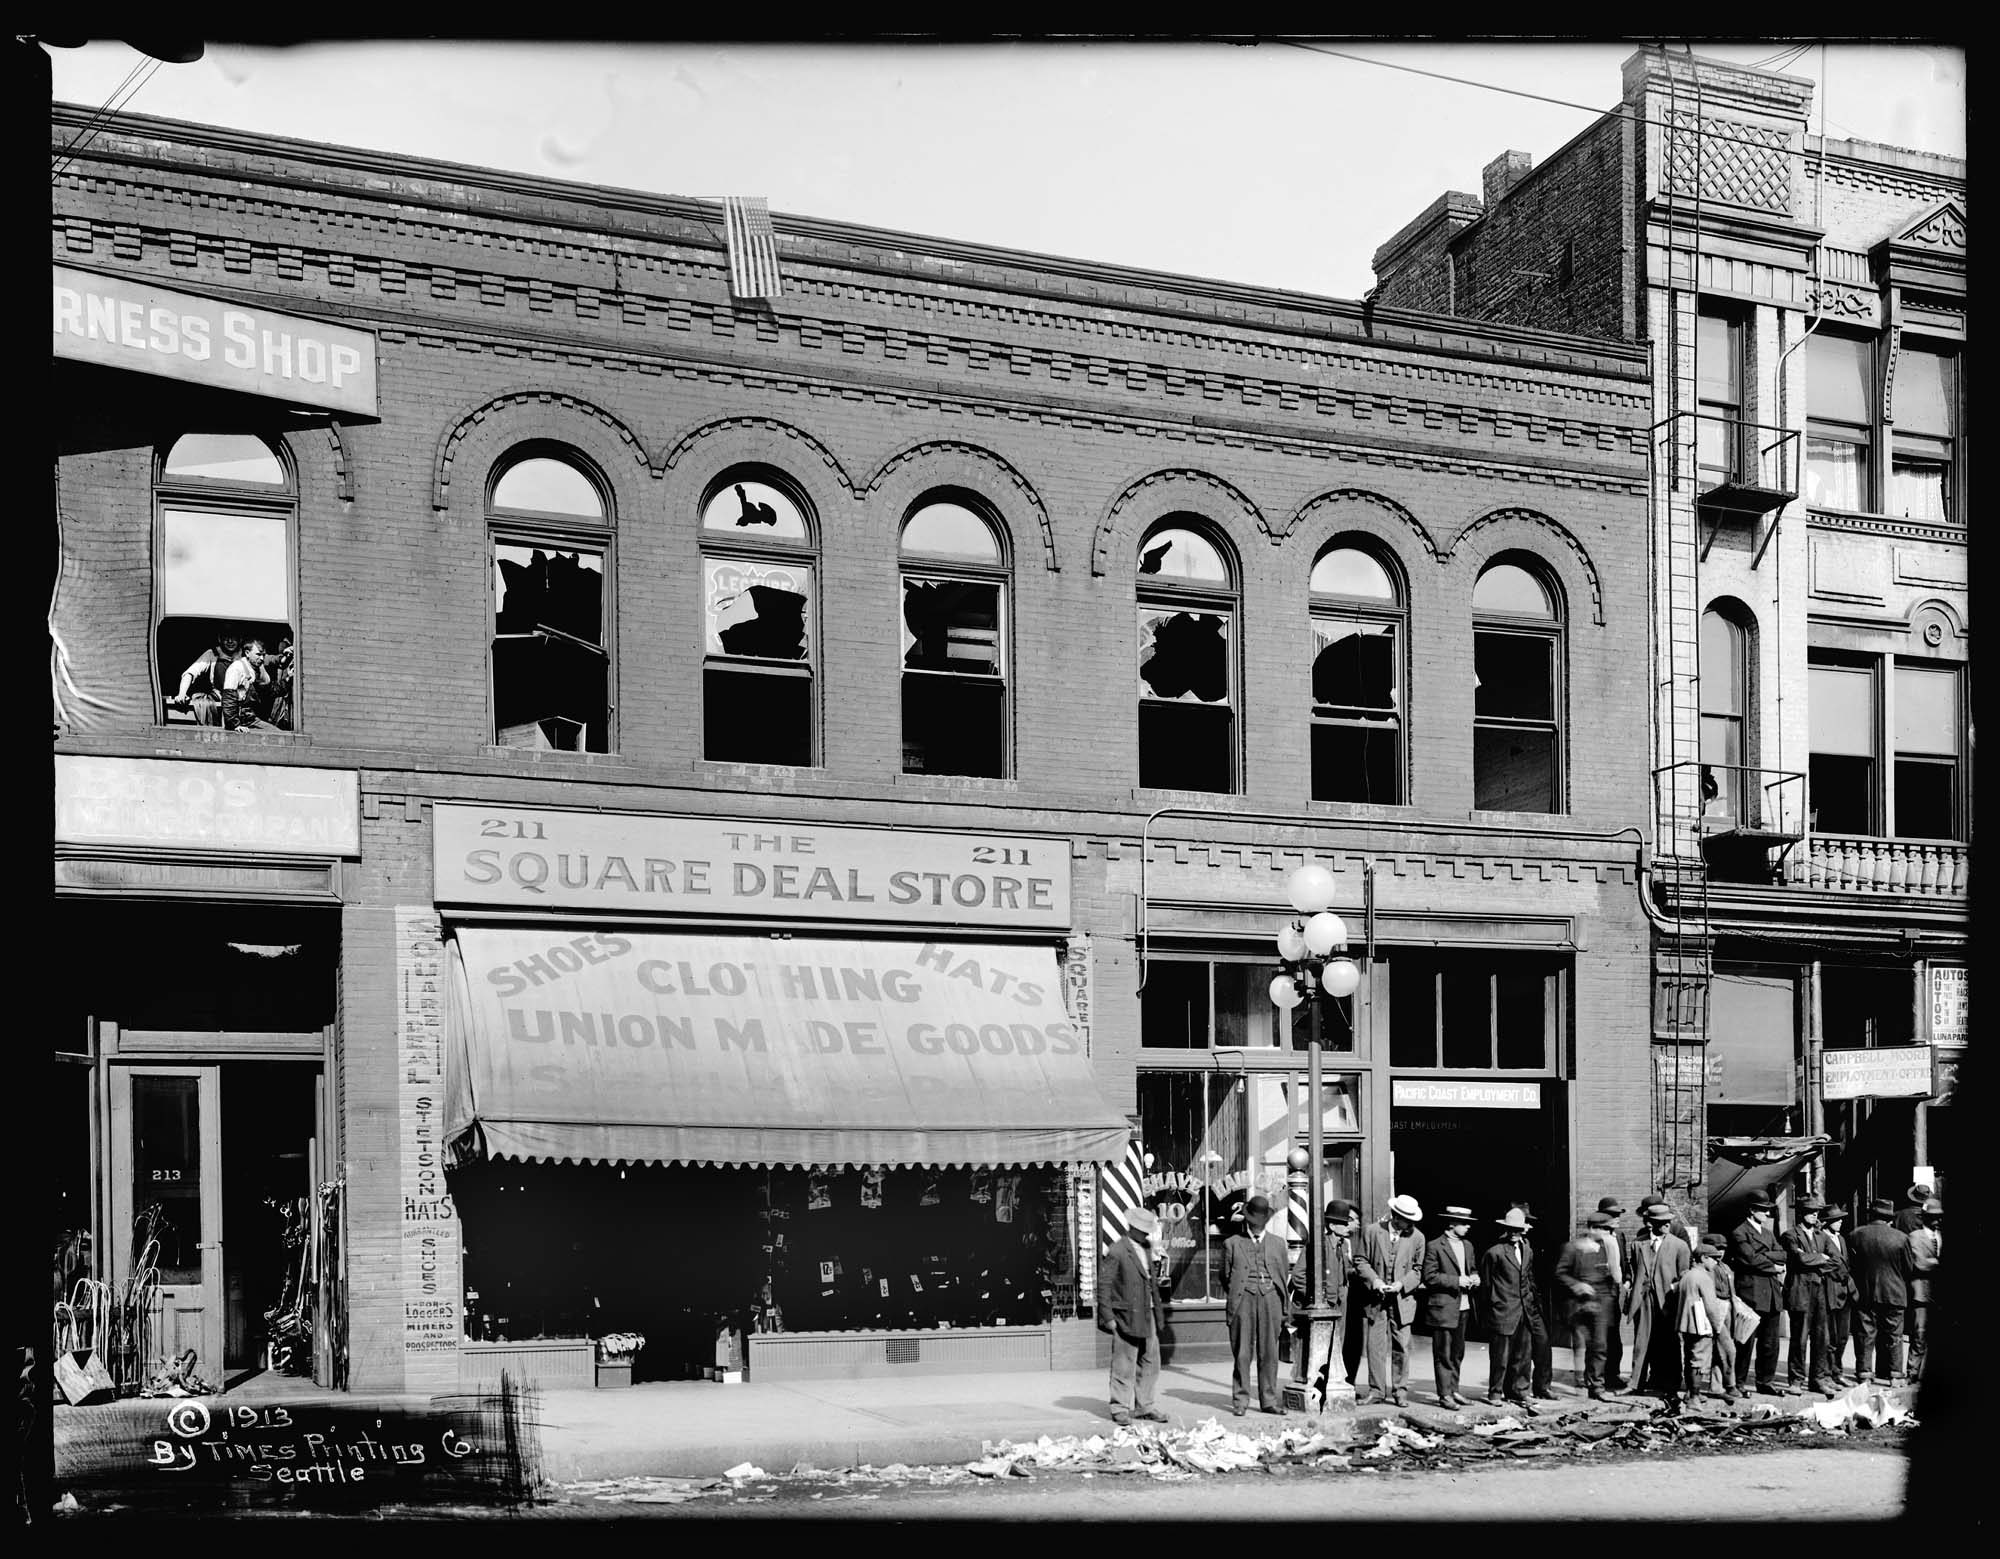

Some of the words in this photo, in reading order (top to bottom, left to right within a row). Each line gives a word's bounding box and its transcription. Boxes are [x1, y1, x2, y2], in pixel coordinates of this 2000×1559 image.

[223, 311, 362, 389] SHOP
[480, 819, 549, 841] 211
[722, 832, 816, 855] THE
[972, 846, 1031, 866] 211
[463, 849, 712, 894] SQUARE
[733, 863, 875, 903] DEAL
[889, 872, 1054, 911] STORE
[486, 932, 632, 998] SHOES
[915, 945, 1045, 1006] HATS
[636, 960, 922, 1004] CLOHING
[507, 1008, 696, 1050] UNION
[713, 1017, 886, 1055] MDE
[906, 1023, 1080, 1056] GOODS
[1825, 1053, 1886, 1065] CAMPBELL
[1394, 1085, 1426, 1100] PACIFIC
[1428, 1086, 1458, 1101] COAST
[1460, 1086, 1521, 1102] EMPLOYMENT
[416, 1097, 435, 1195] STETSON
[152, 1169, 181, 1181] 213
[1142, 1171, 1204, 1198] SHAVE
[405, 1196, 452, 1221] HATS
[1157, 1202, 1186, 1221] 10
[421, 1239, 437, 1295] SHOES
[405, 1302, 454, 1318] LOGGERS
[406, 1322, 454, 1331] MINERS
